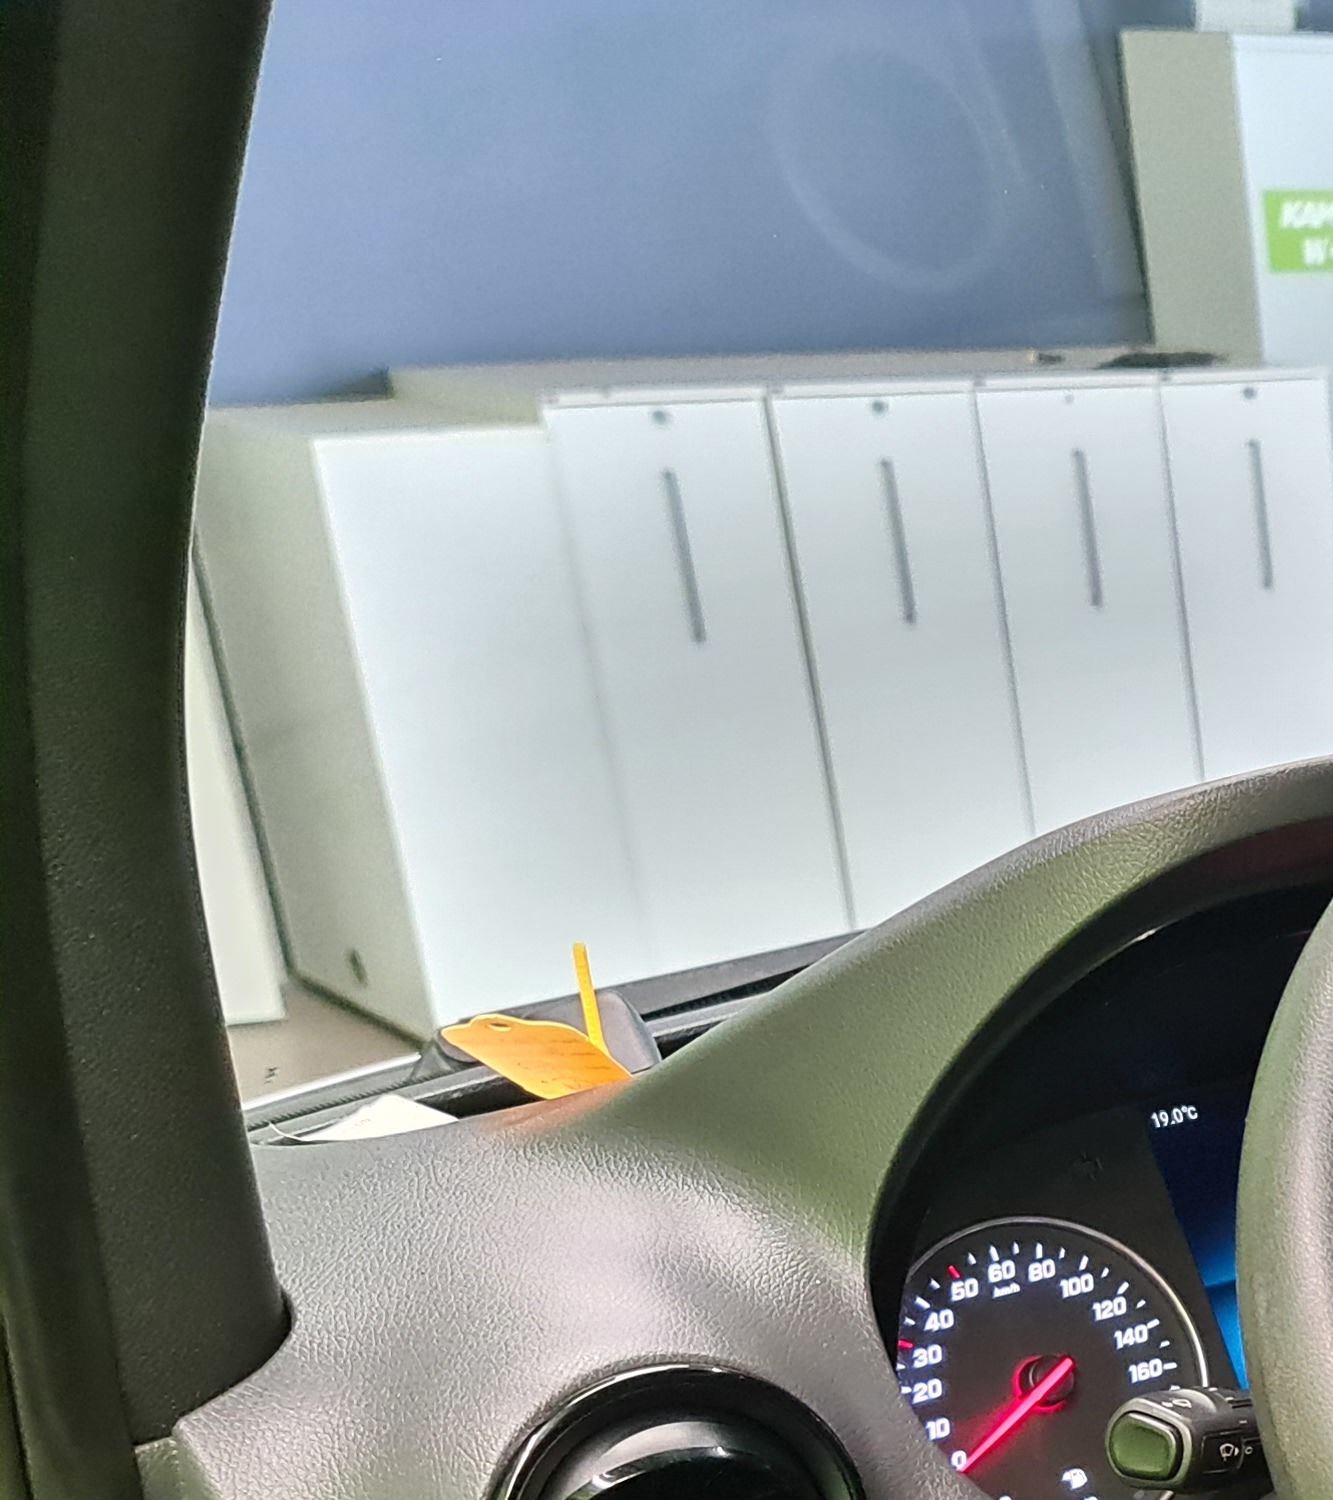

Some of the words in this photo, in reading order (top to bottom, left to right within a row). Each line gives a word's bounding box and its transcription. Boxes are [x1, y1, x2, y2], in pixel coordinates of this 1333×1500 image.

[1151, 1105, 1198, 1128] 19.0°C
[987, 1259, 1015, 1283] 60
[1028, 1258, 1056, 1281] 80
[951, 1277, 979, 1301] 50
[992, 1282, 1020, 1299] km/h
[1060, 1273, 1094, 1299] 100
[924, 1309, 954, 1332] 40
[1092, 1296, 1127, 1321] 120
[1114, 1324, 1148, 1349] 140
[913, 1344, 942, 1368] 30
[1129, 1358, 1163, 1383] 160
[912, 1379, 942, 1403] 20
[926, 1417, 950, 1440] 10
[951, 1450, 967, 1470] 0
